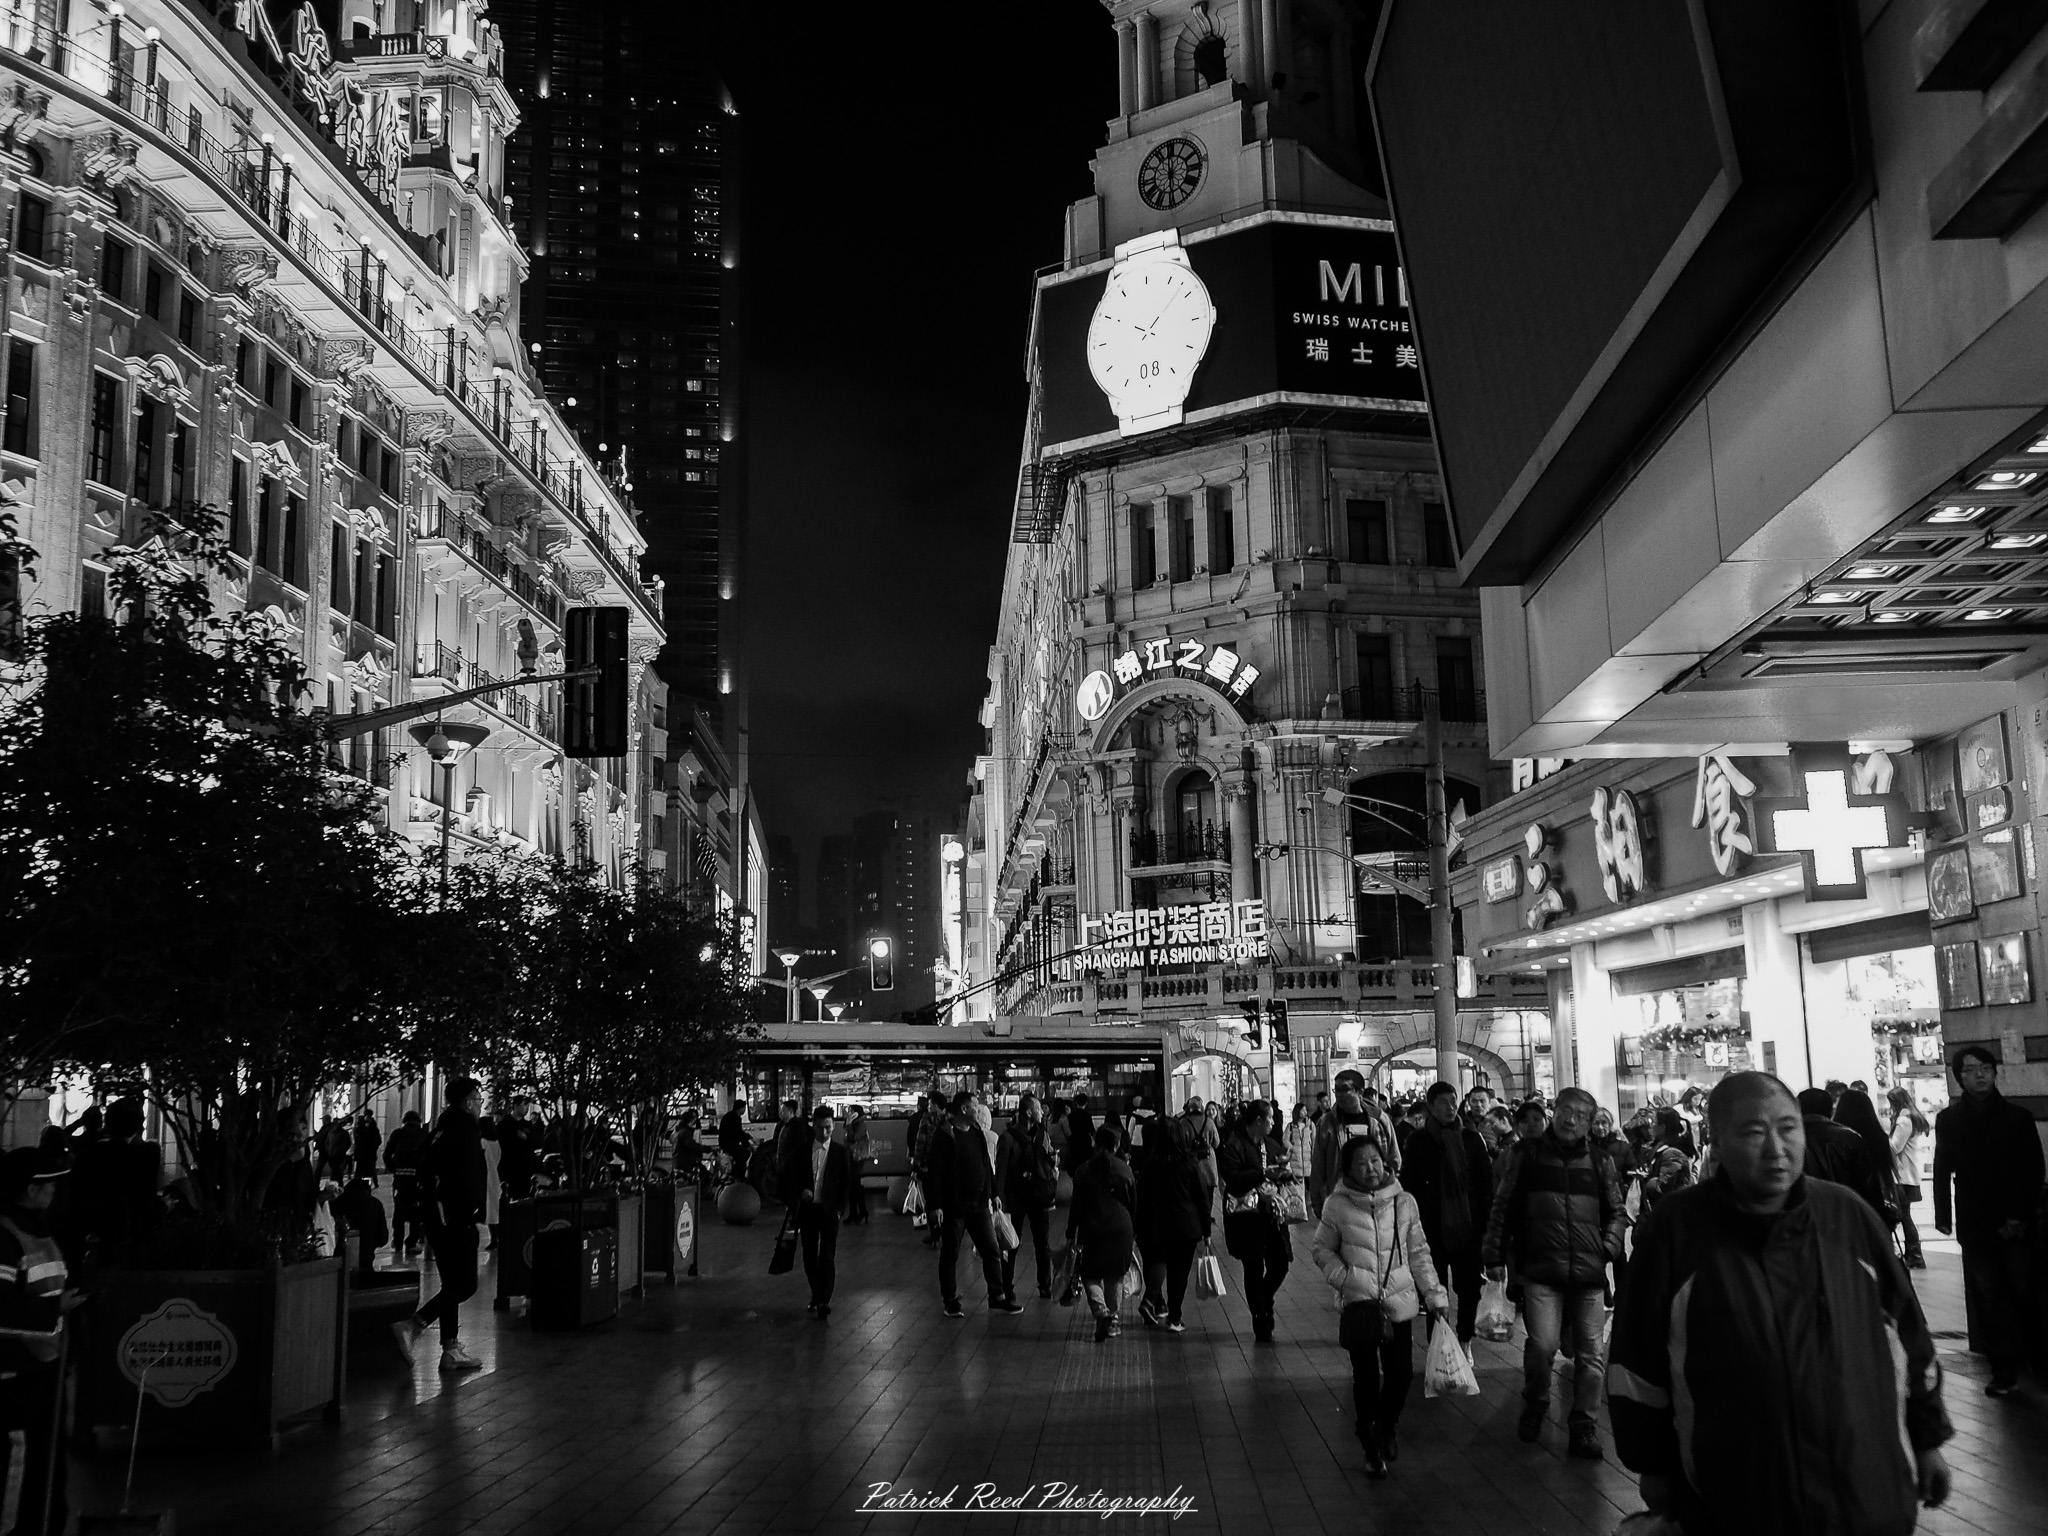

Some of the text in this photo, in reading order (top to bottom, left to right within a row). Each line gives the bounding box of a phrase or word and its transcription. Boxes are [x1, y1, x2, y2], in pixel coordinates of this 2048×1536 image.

[1293, 312, 1410, 333] SWISS WATCHE
[1305, 337, 1418, 369] 瑞士美
[1139, 360, 1161, 381] 08
[1074, 898, 1267, 951] 上海时装商店
[1073, 939, 1268, 972] SHANGHAI FASHION STORE
